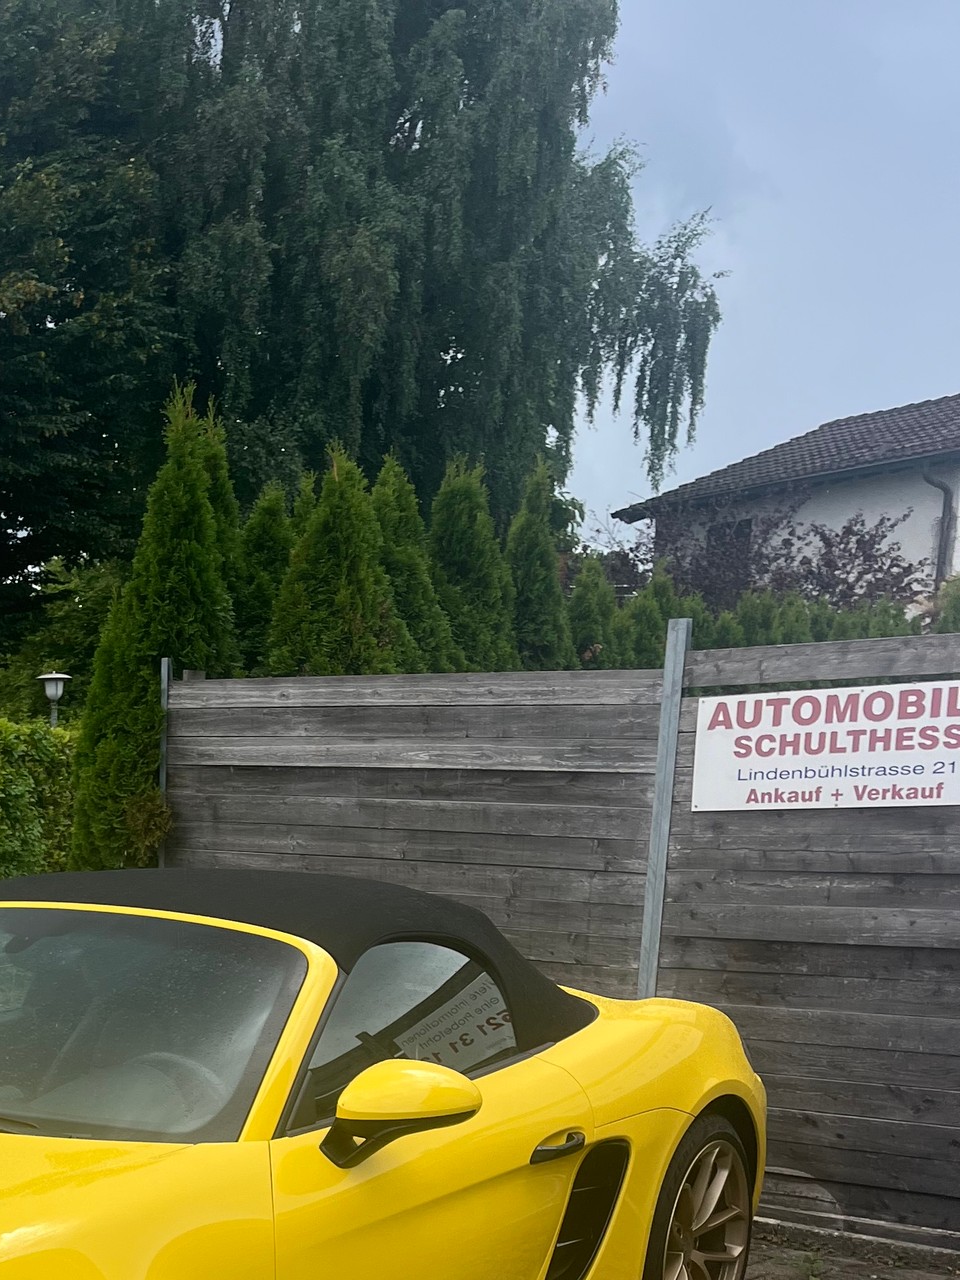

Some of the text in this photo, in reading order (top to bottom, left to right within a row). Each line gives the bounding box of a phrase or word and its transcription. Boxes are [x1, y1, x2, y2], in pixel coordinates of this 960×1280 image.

[707, 686, 960, 731] AUTOMOBIL
[733, 724, 960, 758] SCHULTHESS
[737, 761, 956, 781] Lindenbühlstrasse 21
[745, 782, 945, 804] Ankauf + Verkauf
